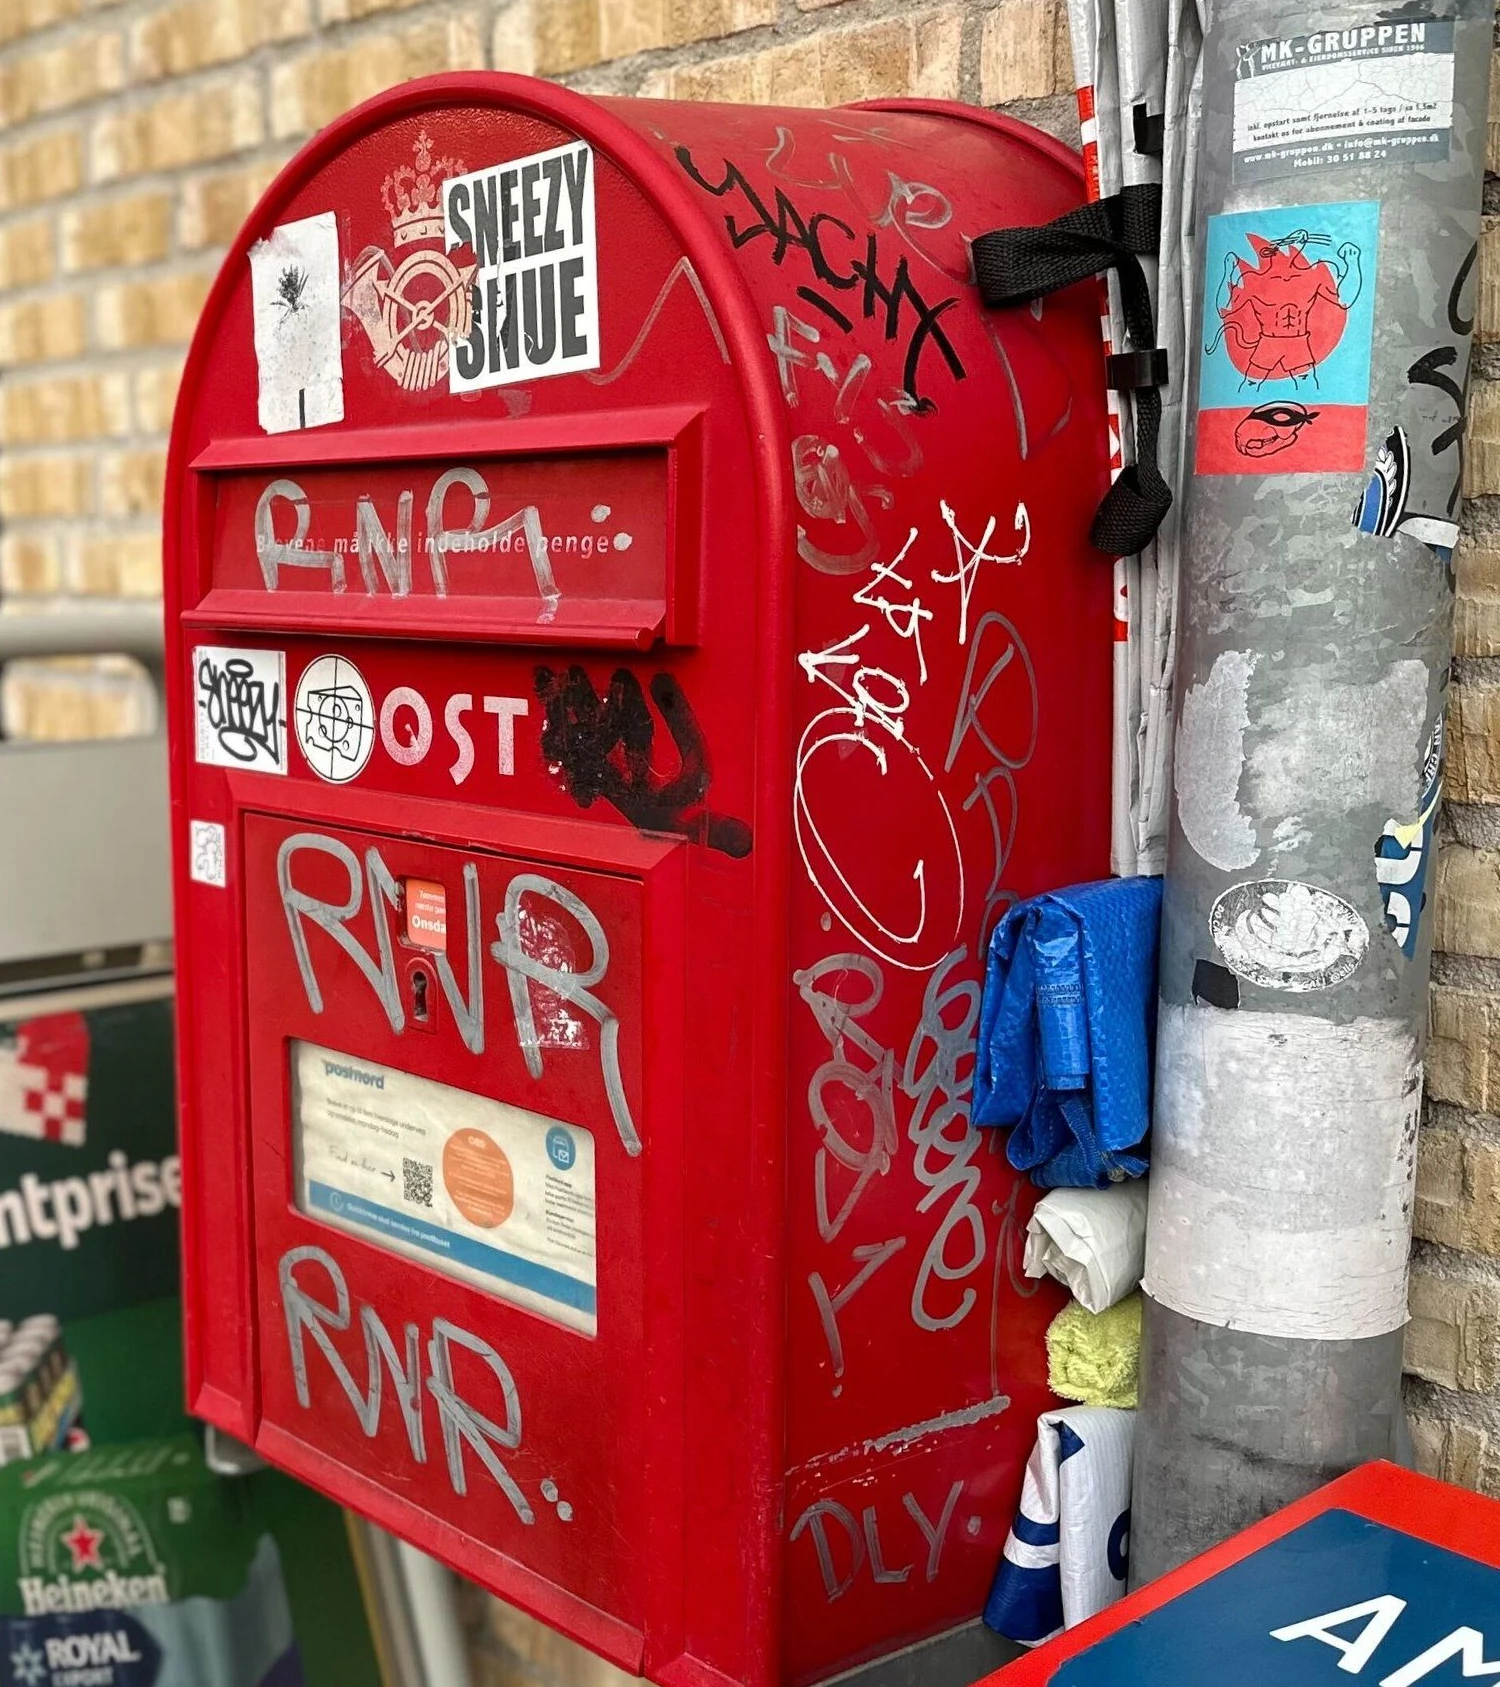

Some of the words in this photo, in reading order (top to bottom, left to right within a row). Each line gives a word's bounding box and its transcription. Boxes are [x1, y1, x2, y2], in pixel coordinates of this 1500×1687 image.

[1260, 22, 1426, 64] MK-GRUPPEN
[1252, 130, 1280, 142] kontakt
[1291, 126, 1304, 136] for
[1305, 119, 1356, 134] abonnement
[1366, 116, 1396, 127] coating
[1397, 115, 1405, 124] af
[1263, 117, 1291, 130] opstart
[1292, 114, 1311, 124] samt
[1312, 109, 1350, 122] fjernelse
[1351, 107, 1360, 116] af
[1363, 105, 1378, 114] 1-5
[1379, 104, 1397, 115] tags
[1292, 154, 1324, 168] Mobil:
[1326, 153, 1340, 164] 30
[1342, 150, 1355, 162] 51
[1373, 149, 1387, 159] 24
[448, 146, 589, 269] SNEEZY
[333, 530, 360, 554] må
[416, 530, 526, 554] indeholde
[536, 533, 610, 560] penge
[18, 1568, 169, 1617] Heineken
[44, 1630, 142, 1670] ROYAL
